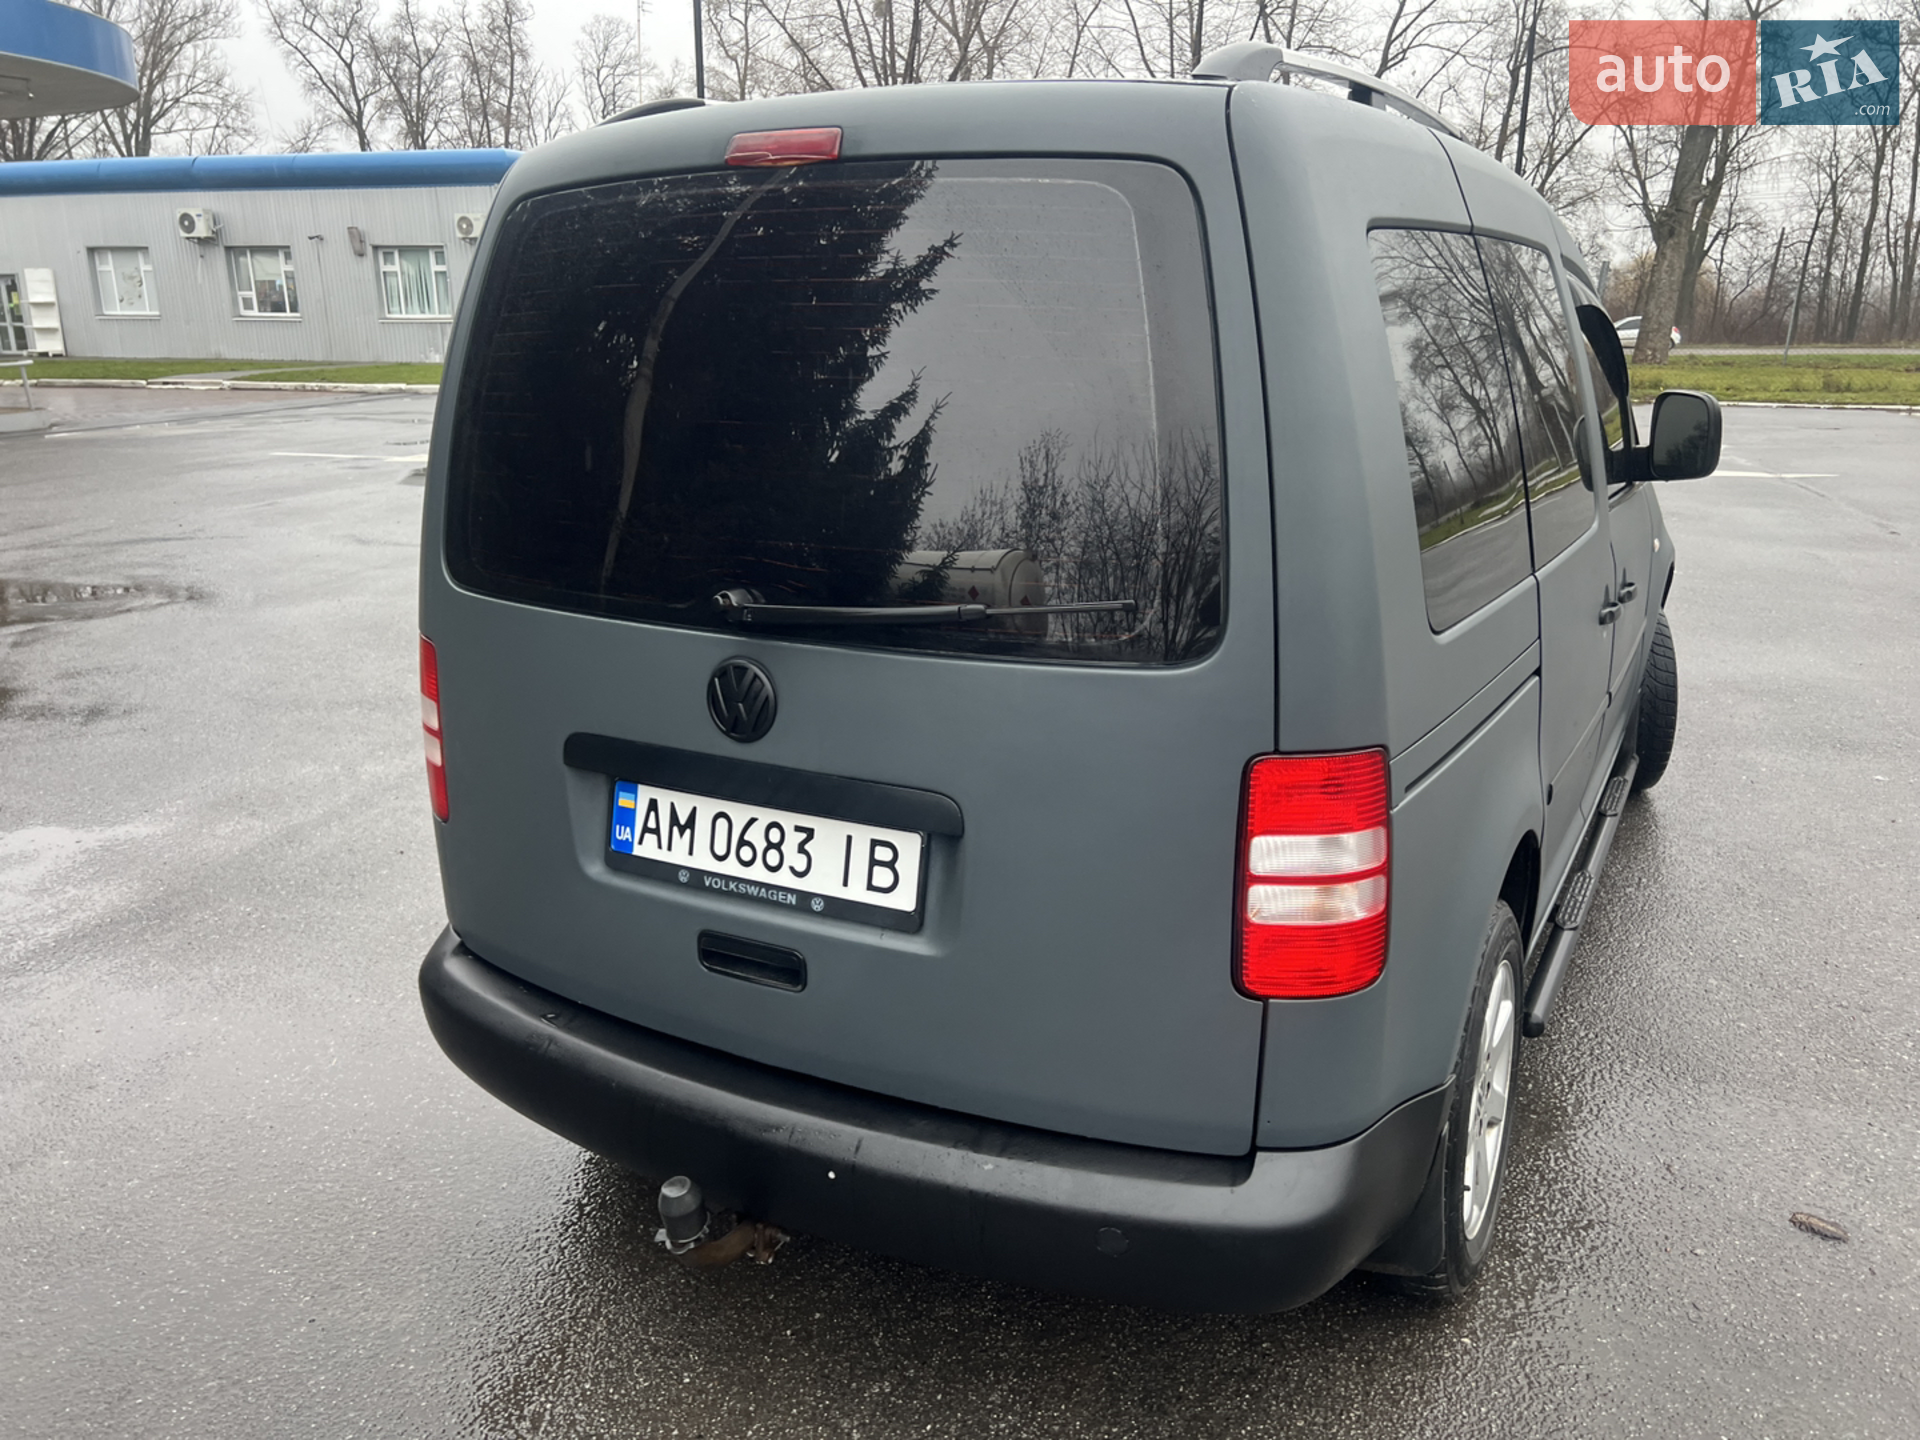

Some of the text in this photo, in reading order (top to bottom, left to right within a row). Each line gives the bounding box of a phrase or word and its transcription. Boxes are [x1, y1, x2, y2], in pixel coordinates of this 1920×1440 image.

[615, 824, 633, 842] UA
[637, 797, 901, 894] AM 0683 IB
[703, 874, 798, 906] VOLKSWAGEN
